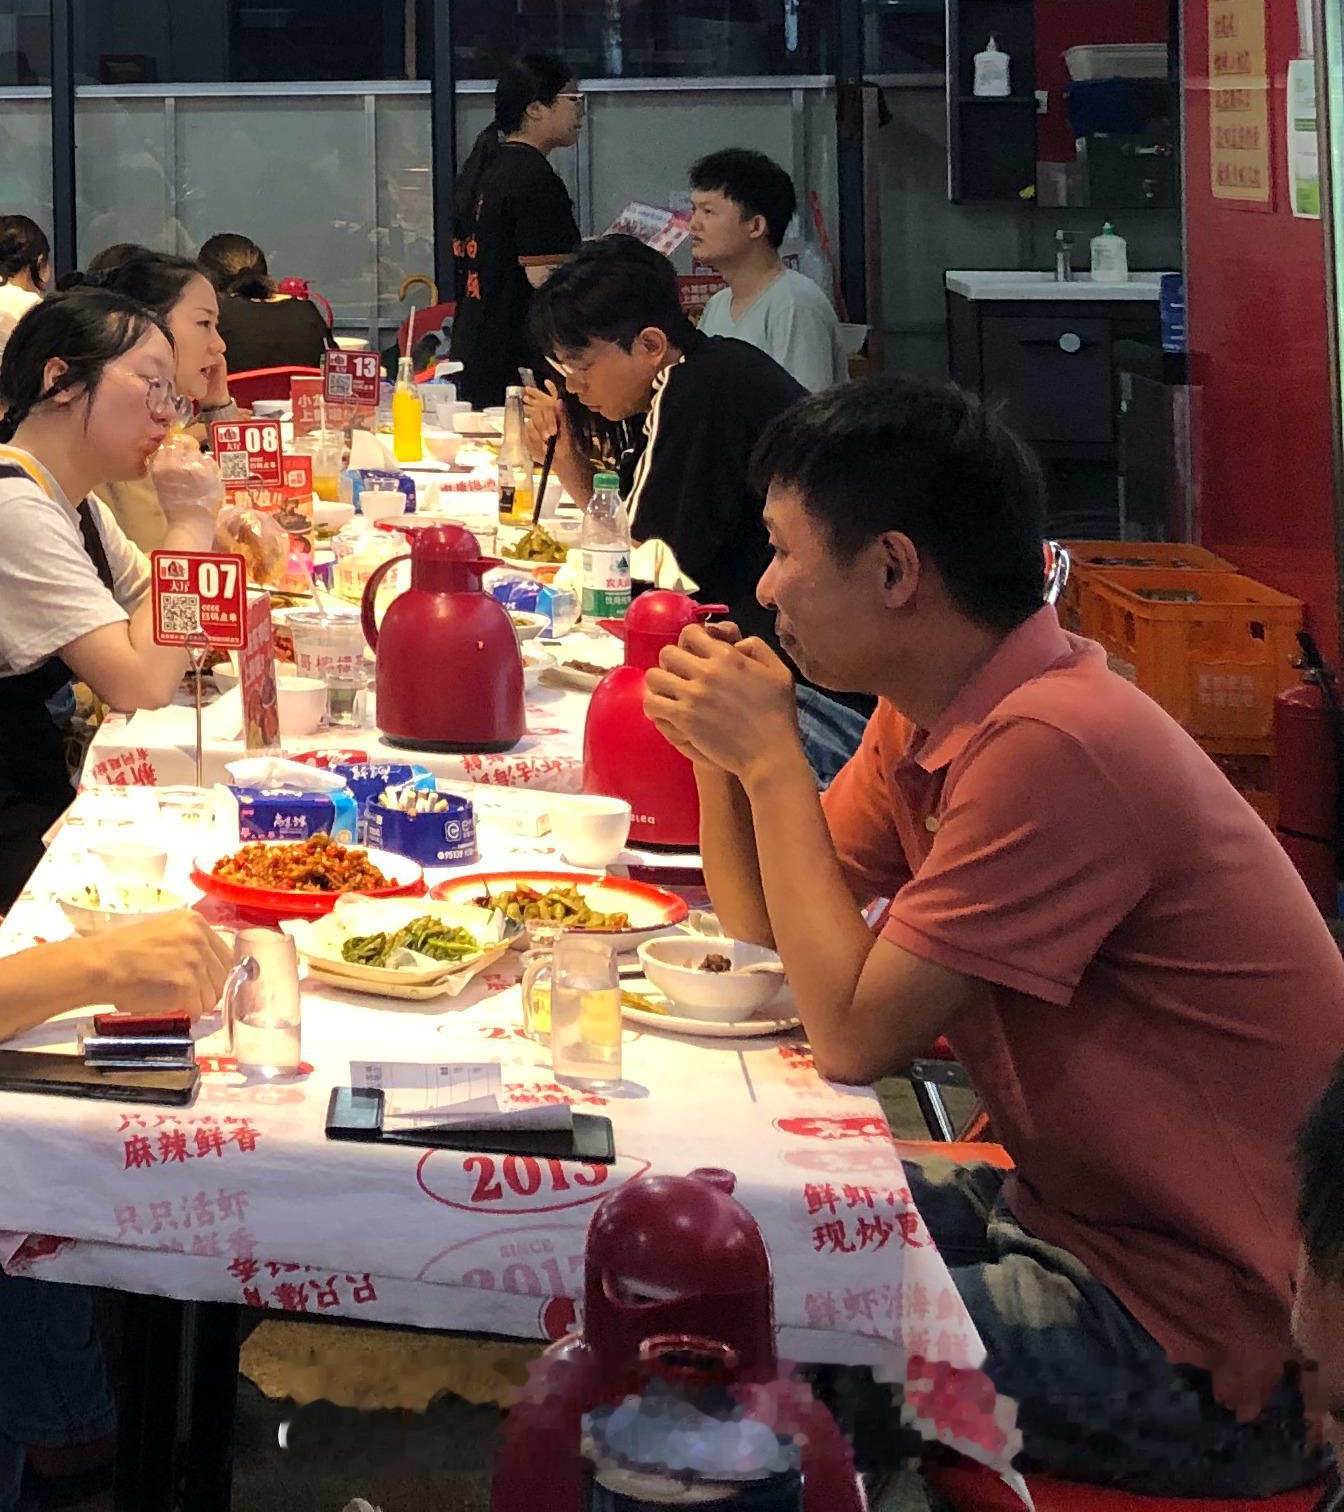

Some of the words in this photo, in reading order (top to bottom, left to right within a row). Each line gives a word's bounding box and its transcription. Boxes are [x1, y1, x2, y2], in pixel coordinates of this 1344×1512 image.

[353, 357, 376, 377] 13
[245, 427, 278, 453] 08
[198, 563, 237, 599] 07
[123, 1128, 261, 1170] 麻辣鲜香
[812, 1211, 939, 1254] 现炒更
